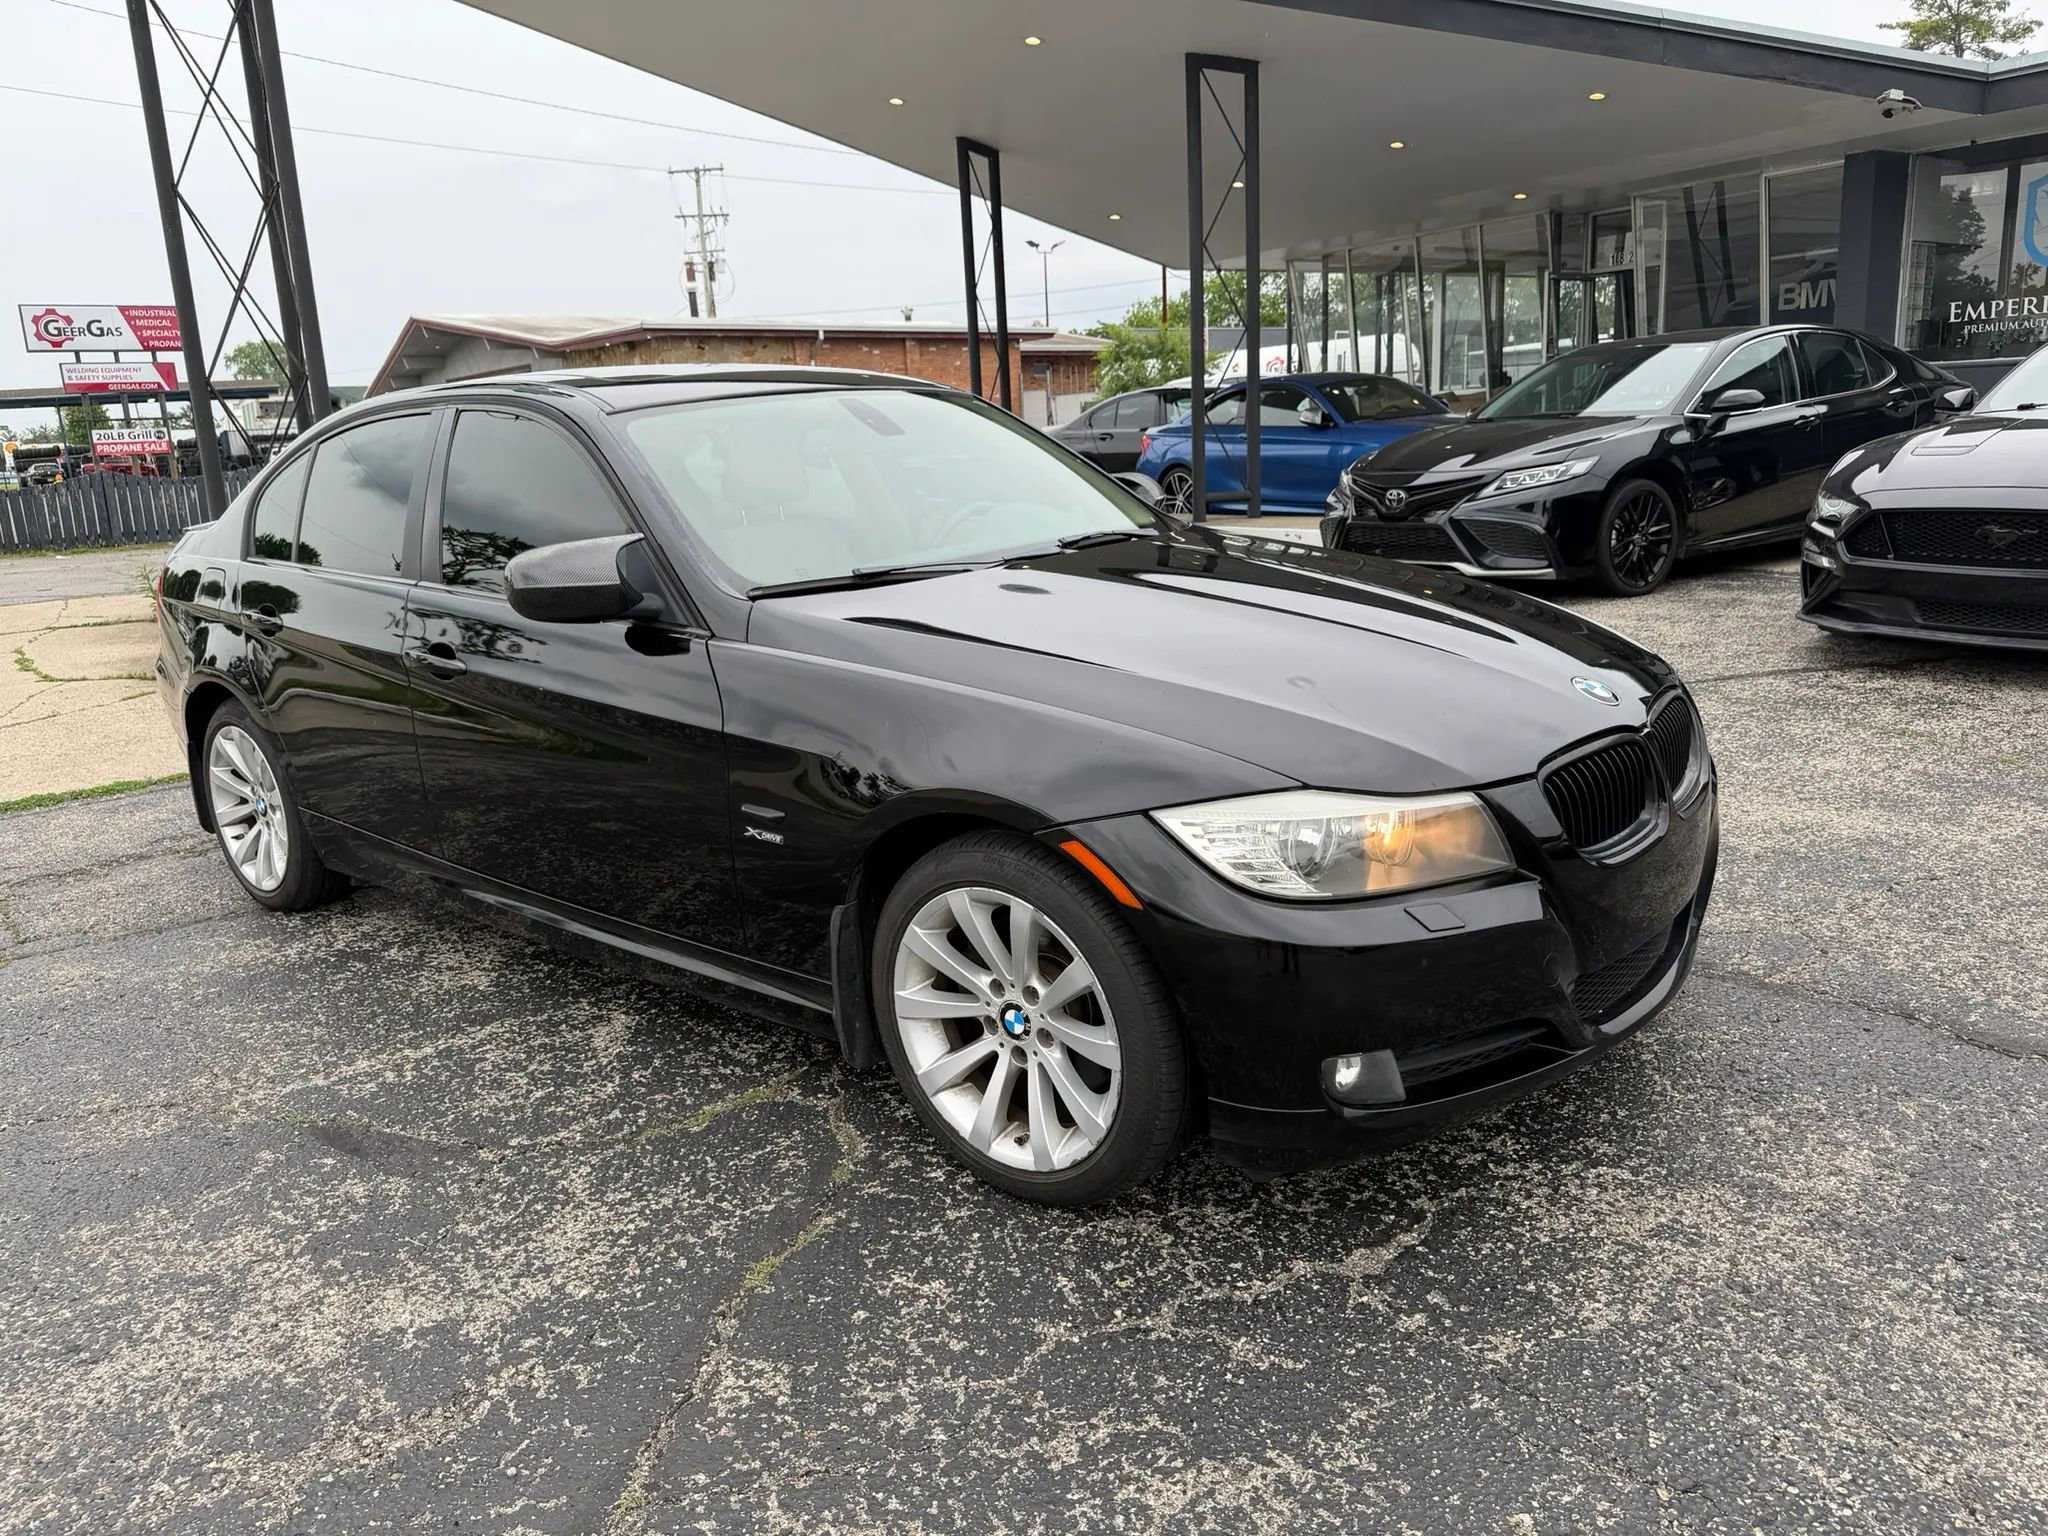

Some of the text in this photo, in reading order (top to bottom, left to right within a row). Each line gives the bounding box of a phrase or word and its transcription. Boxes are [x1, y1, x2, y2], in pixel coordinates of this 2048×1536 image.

[129, 309, 177, 317] INDUSTRIAL
[136, 319, 172, 327] MEDICAL
[1964, 321, 2019, 334] PREMIUM
[142, 329, 181, 337] SPECIALTY
[96, 431, 125, 441] 20LB
[128, 430, 152, 440] Grill
[96, 442, 169, 453] PROPANE SALE
